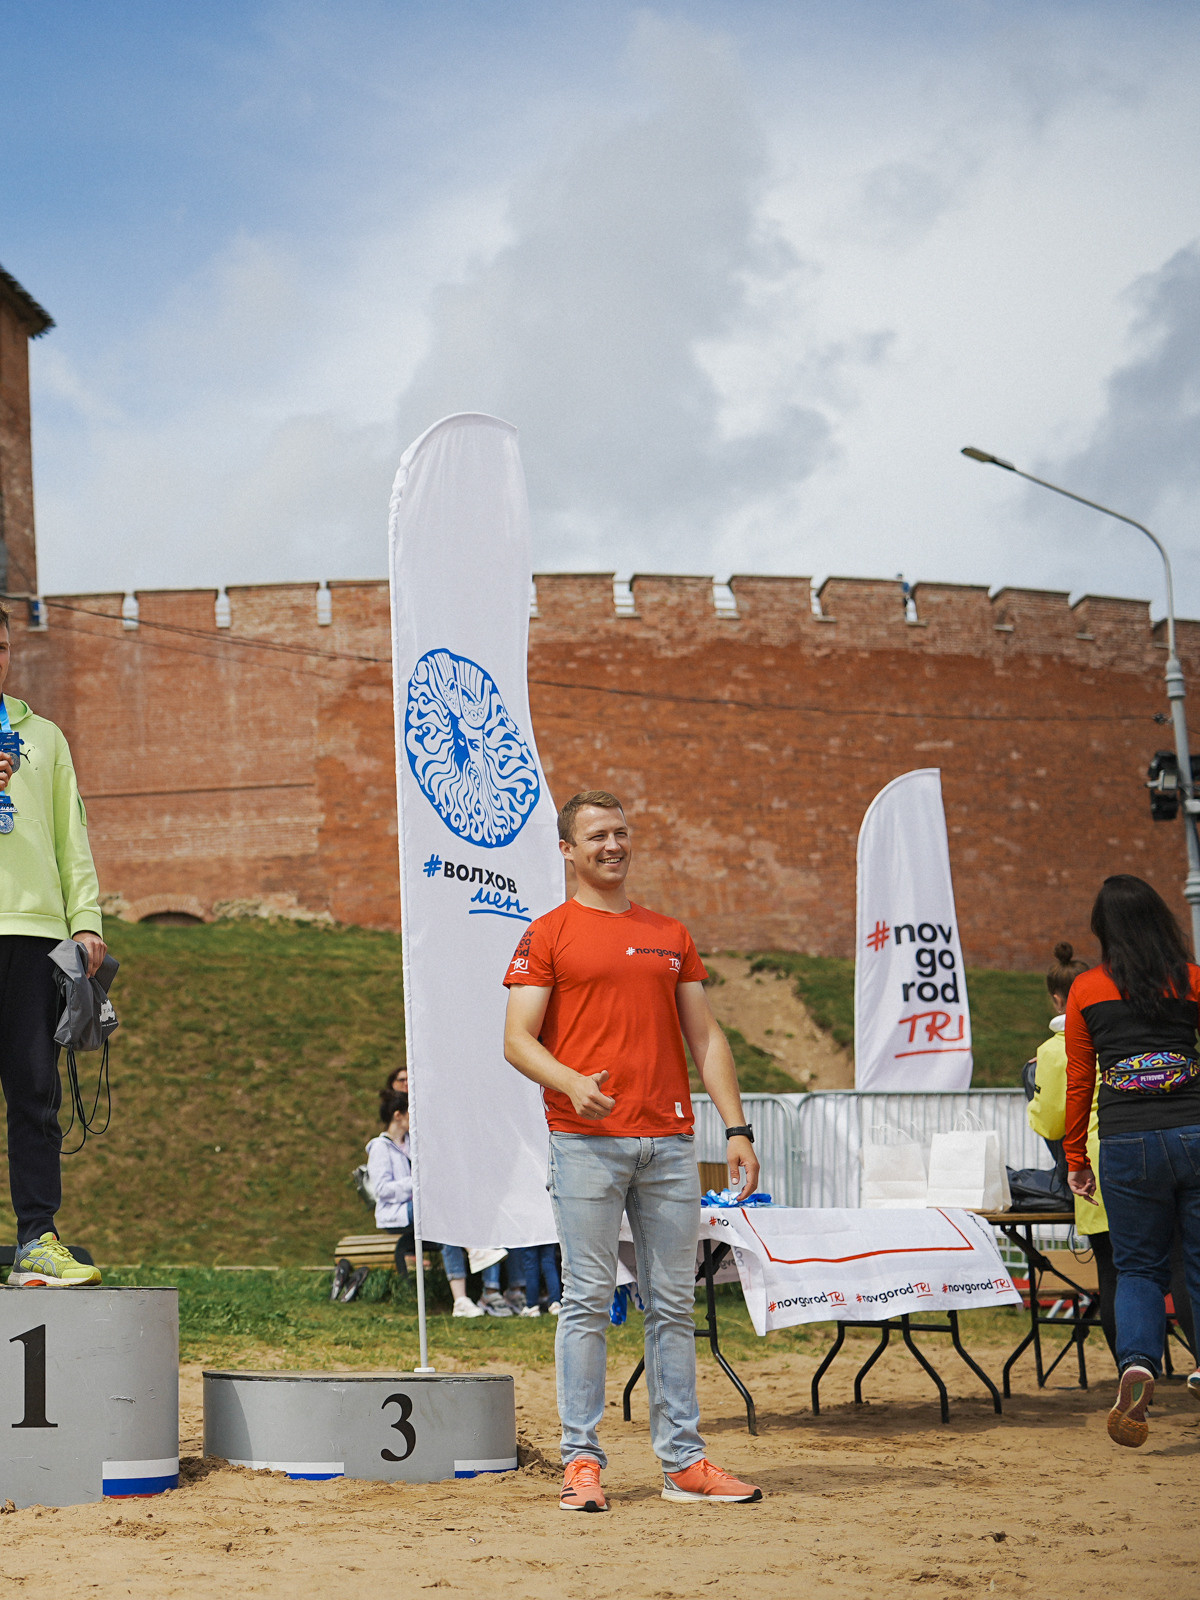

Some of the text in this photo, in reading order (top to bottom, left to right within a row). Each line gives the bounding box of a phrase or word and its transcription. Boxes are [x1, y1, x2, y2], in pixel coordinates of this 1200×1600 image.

[866, 921, 952, 951] #nov
[625, 946, 681, 961] #novgorod
[915, 947, 955, 977] go
[902, 972, 960, 1003] rod
[898, 1011, 964, 1042] TRI
[9, 1324, 58, 1428] 1
[380, 1393, 416, 1462] 3
